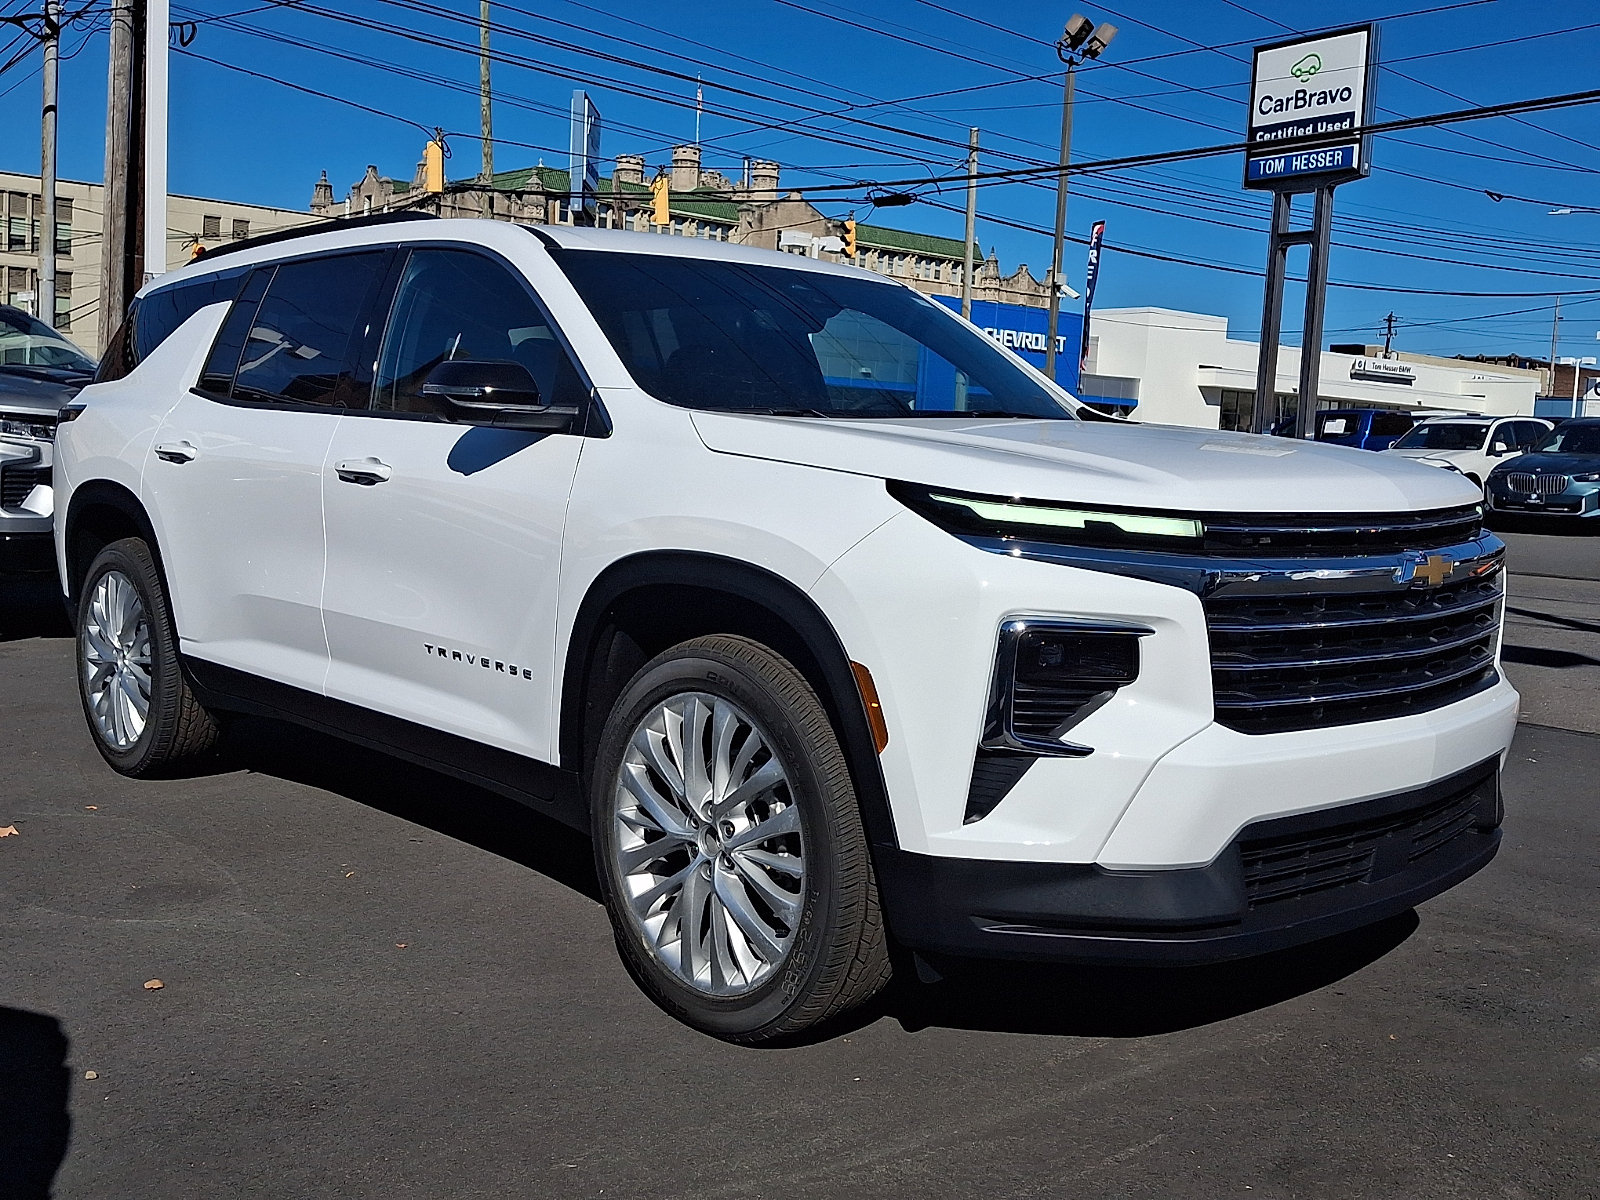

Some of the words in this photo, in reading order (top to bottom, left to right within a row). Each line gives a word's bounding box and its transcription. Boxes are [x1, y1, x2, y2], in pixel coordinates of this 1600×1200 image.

[1259, 86, 1352, 115] CarBravo
[1256, 124, 1313, 141] Certified
[1318, 118, 1350, 132] Used
[1259, 157, 1285, 175] TOM
[1292, 150, 1342, 171] HESSER
[983, 327, 1066, 352] CHEVROLT
[424, 644, 532, 680] TRAVERSE
